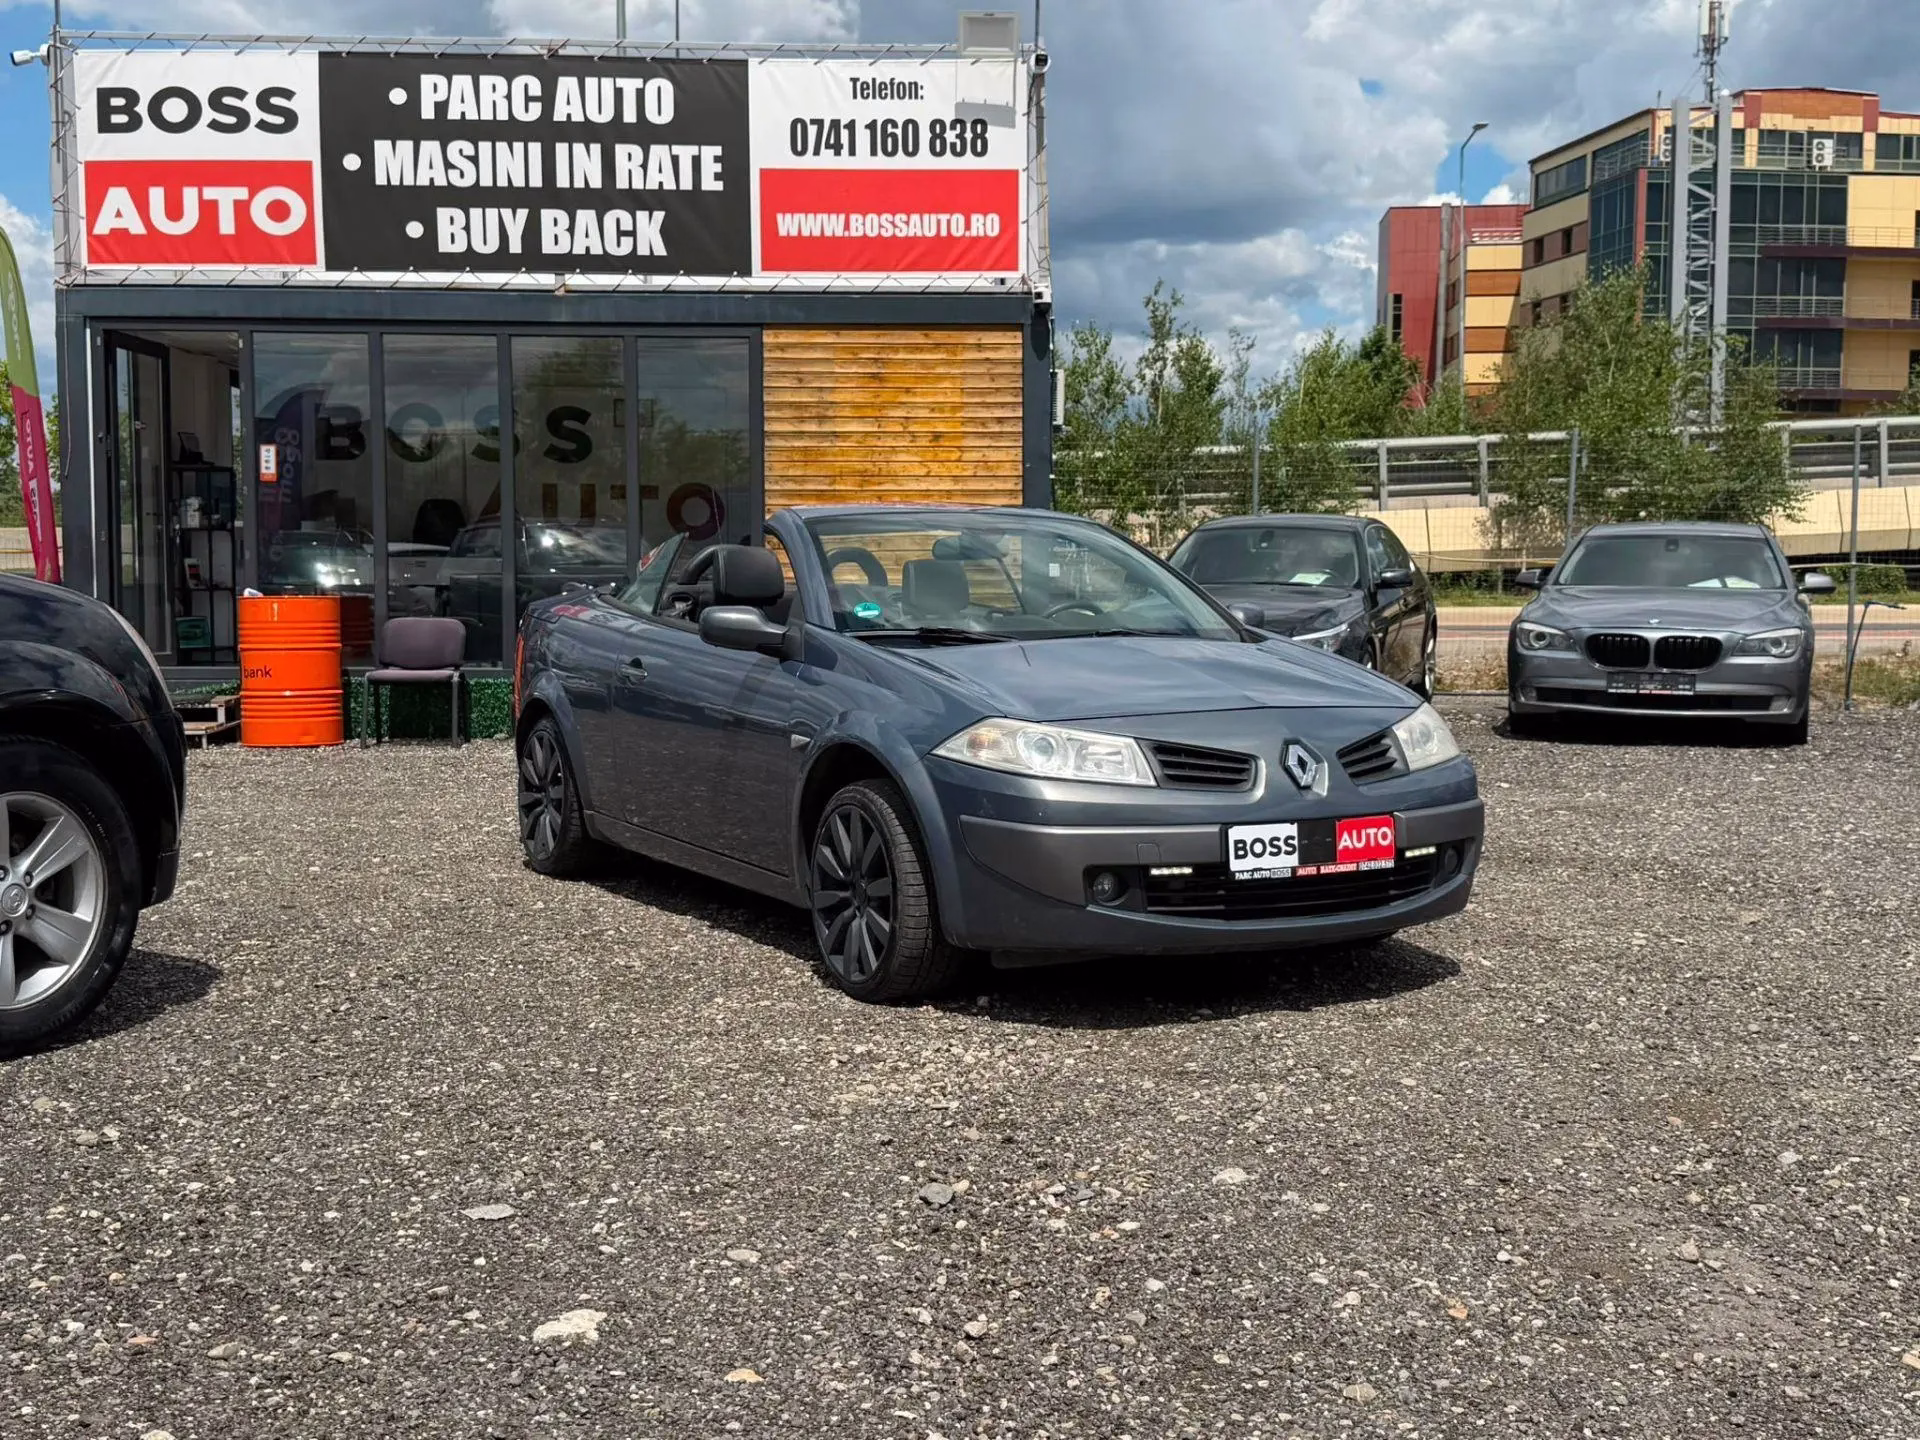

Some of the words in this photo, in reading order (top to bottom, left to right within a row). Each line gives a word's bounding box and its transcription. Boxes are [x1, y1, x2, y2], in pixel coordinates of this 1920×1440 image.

[420, 74, 543, 122] PARC
[553, 76, 675, 125] AUTO
[849, 77, 925, 101] Telefon:
[97, 87, 299, 135] BOSS
[790, 117, 857, 157] 0741
[864, 118, 920, 158] 160
[929, 117, 989, 158] 838
[374, 139, 543, 188] MASINI
[555, 142, 603, 189] IN
[614, 144, 724, 191] RATE
[92, 186, 307, 236] AUTO
[776, 213, 1001, 238] WWW.BOSSAUTO.RO
[436, 207, 529, 254] BUY
[540, 208, 668, 256] BACK
[243, 666, 272, 679] bank
[1233, 835, 1297, 860] BOSS
[1338, 826, 1392, 850] AUTO
[1253, 870, 1270, 879] AUTO
